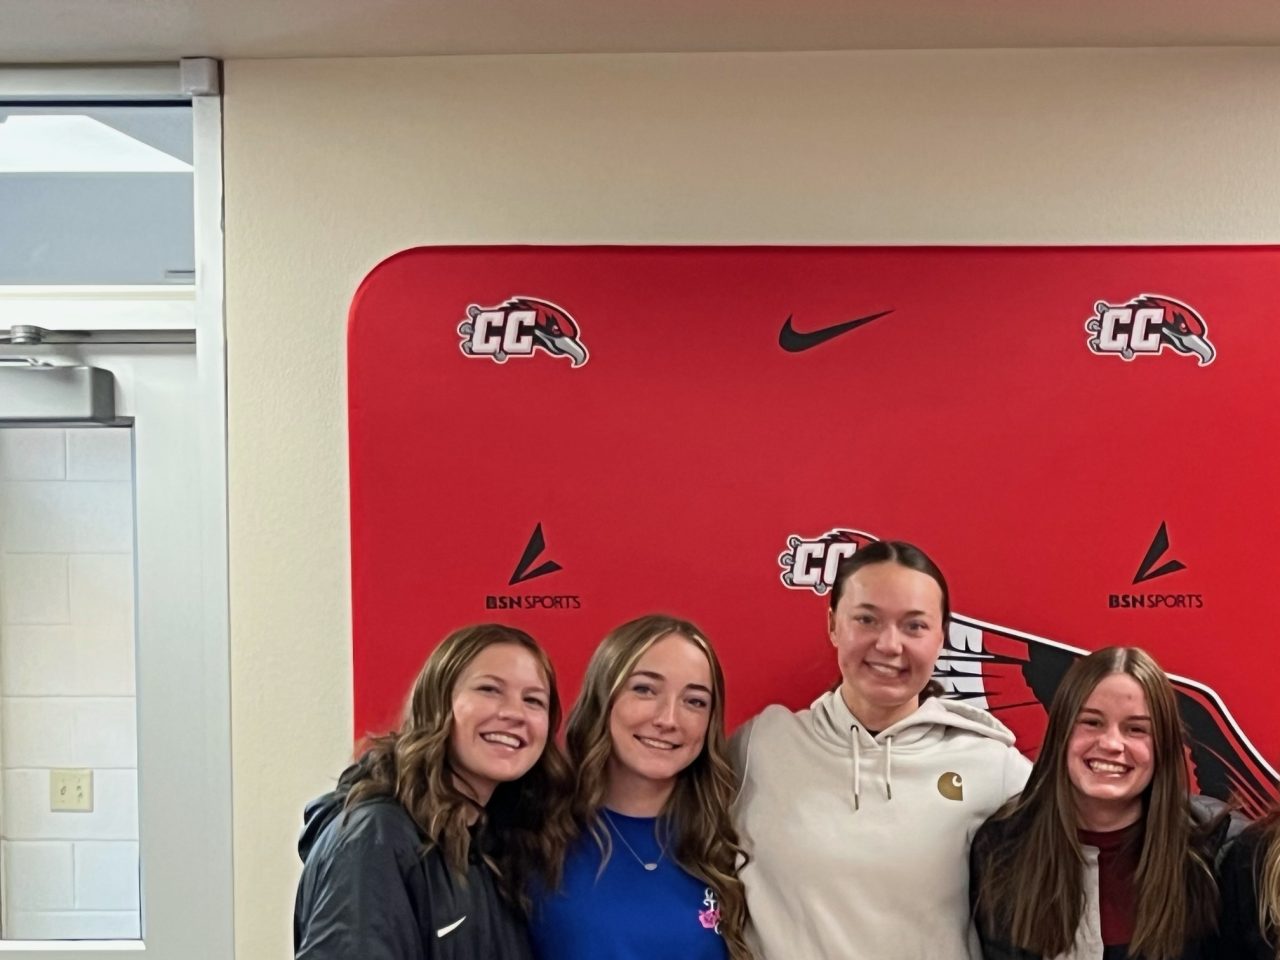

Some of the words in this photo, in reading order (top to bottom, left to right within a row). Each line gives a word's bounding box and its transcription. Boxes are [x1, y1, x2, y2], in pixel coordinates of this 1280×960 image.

[472, 310, 537, 354] CC
[1099, 308, 1165, 351] CC
[485, 595, 522, 609] BSN
[524, 595, 581, 609] SPORTS
[1108, 594, 1145, 608] BSN
[1146, 594, 1203, 608] SPORTS
